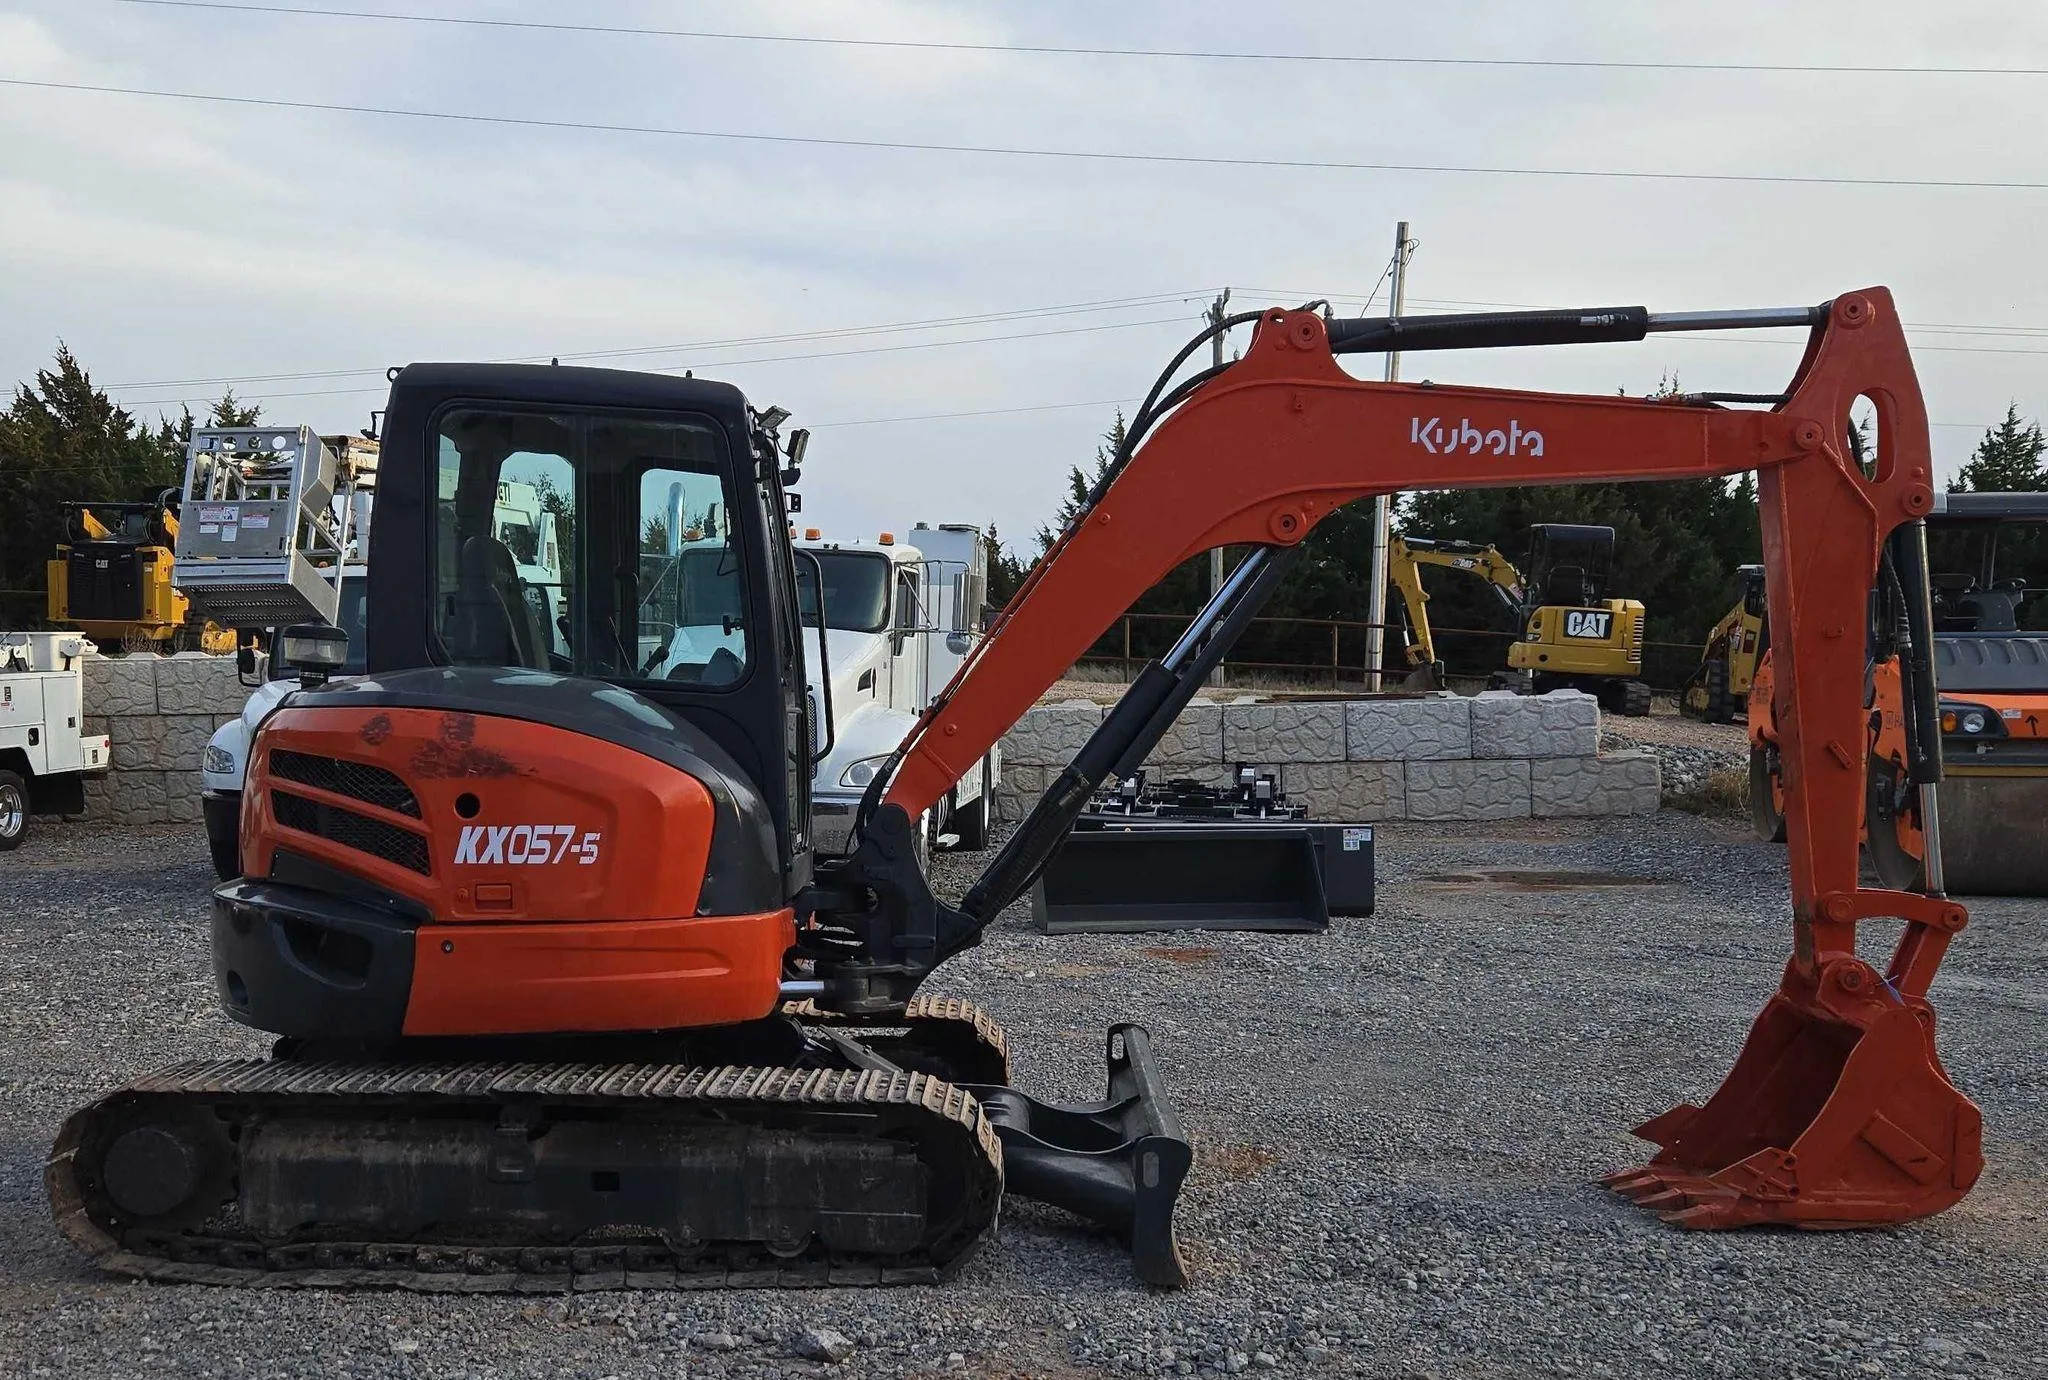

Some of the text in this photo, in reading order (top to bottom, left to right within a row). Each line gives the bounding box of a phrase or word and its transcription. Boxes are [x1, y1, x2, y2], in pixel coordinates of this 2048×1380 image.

[1411, 417, 1544, 457] Kubota
[95, 559, 109, 569] CAT
[1567, 611, 1610, 638] CAT
[453, 824, 601, 865] KX057-5
